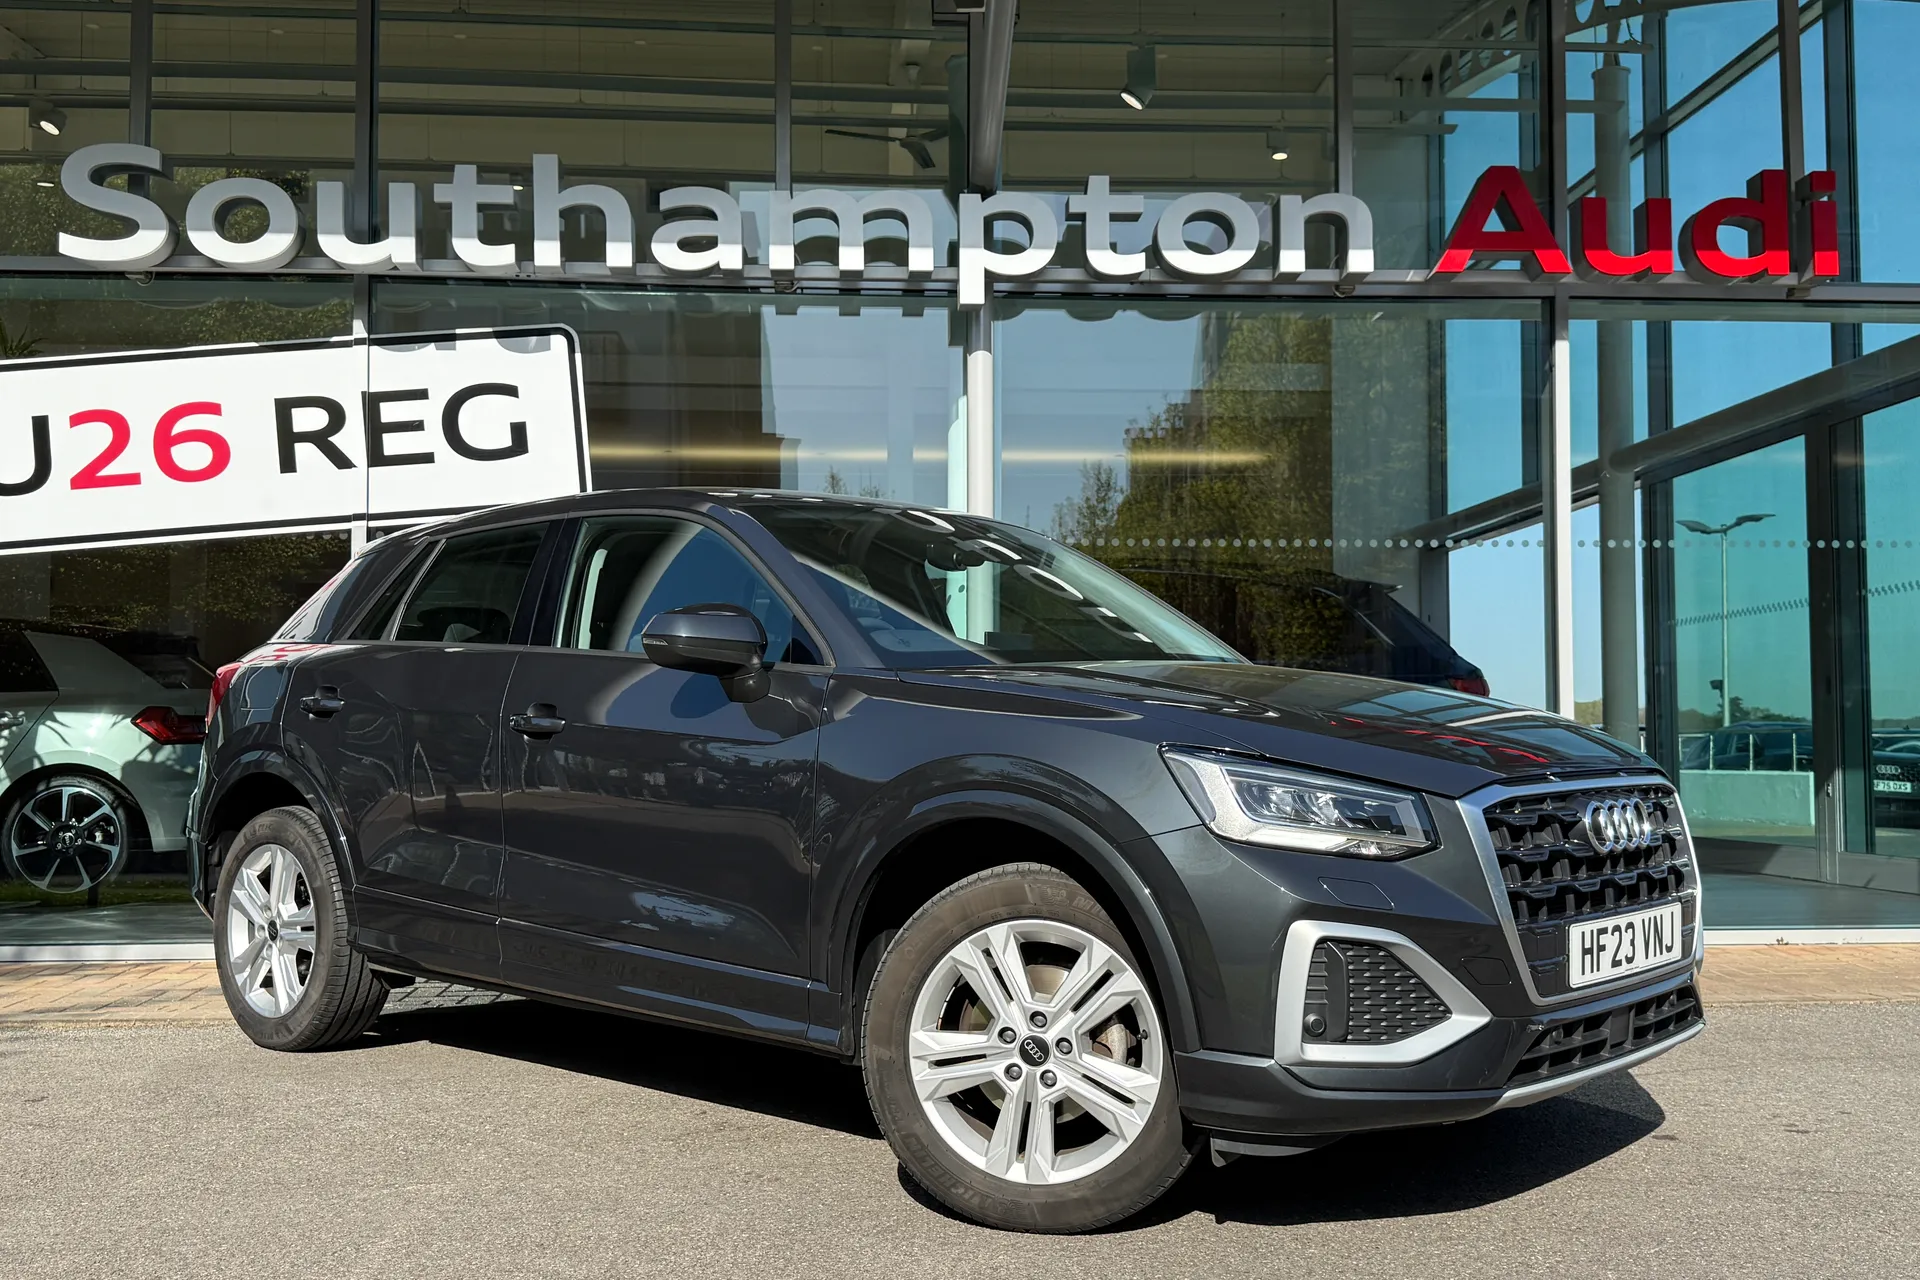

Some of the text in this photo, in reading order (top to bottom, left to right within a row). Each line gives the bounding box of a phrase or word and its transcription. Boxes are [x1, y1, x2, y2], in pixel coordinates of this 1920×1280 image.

[58, 143, 1840, 305] Southampton Audi
[274, 382, 530, 474] REG
[1581, 911, 1674, 976] HF23 VNJ
